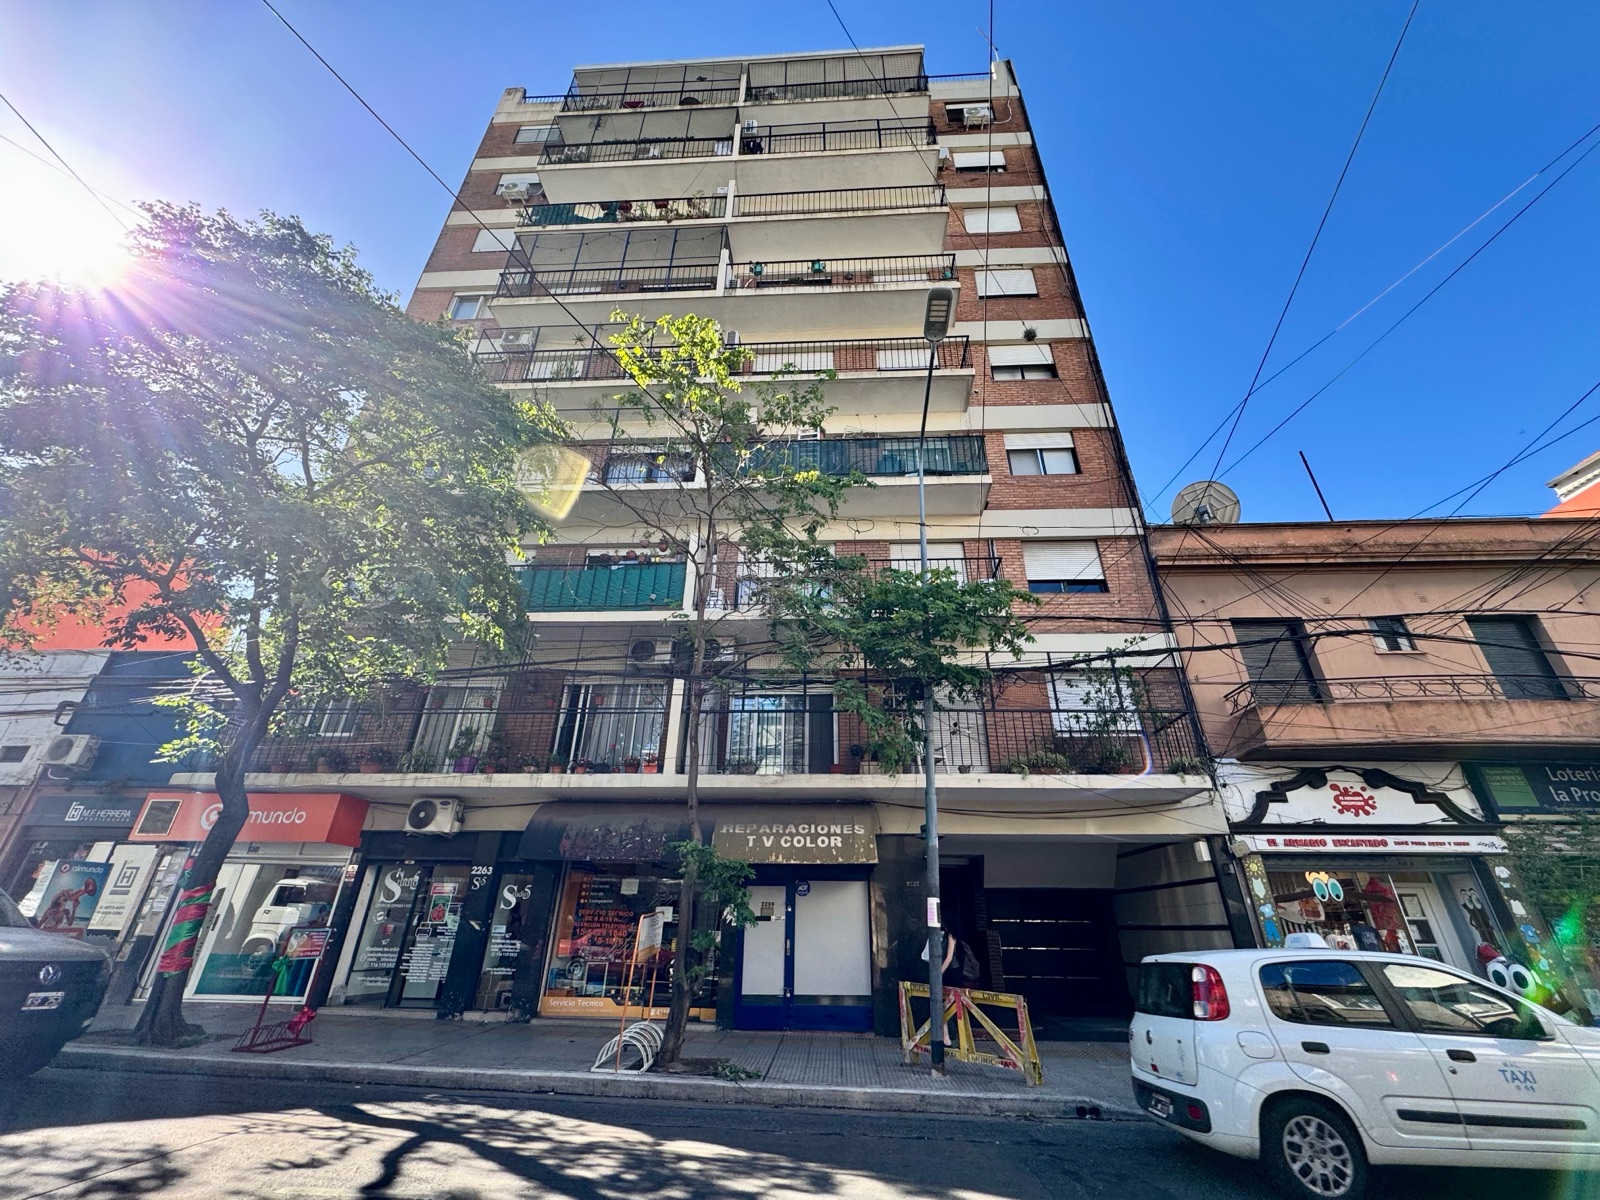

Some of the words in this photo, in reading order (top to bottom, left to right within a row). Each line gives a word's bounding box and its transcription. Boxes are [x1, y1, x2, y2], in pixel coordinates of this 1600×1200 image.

[1545, 766, 1600, 781] Loterí
[1548, 785, 1570, 802] la
[97, 809, 131, 818] HERRERA
[249, 807, 307, 824] mundo
[720, 824, 865, 834] REPARACIONES
[781, 836, 842, 848] COLOR
[72, 864, 104, 874] almundo
[471, 866, 493, 875] 2263
[982, 992, 1002, 1000] CIVIL
[549, 999, 576, 1007] Servicio
[1498, 1069, 1538, 1084] TAXI
